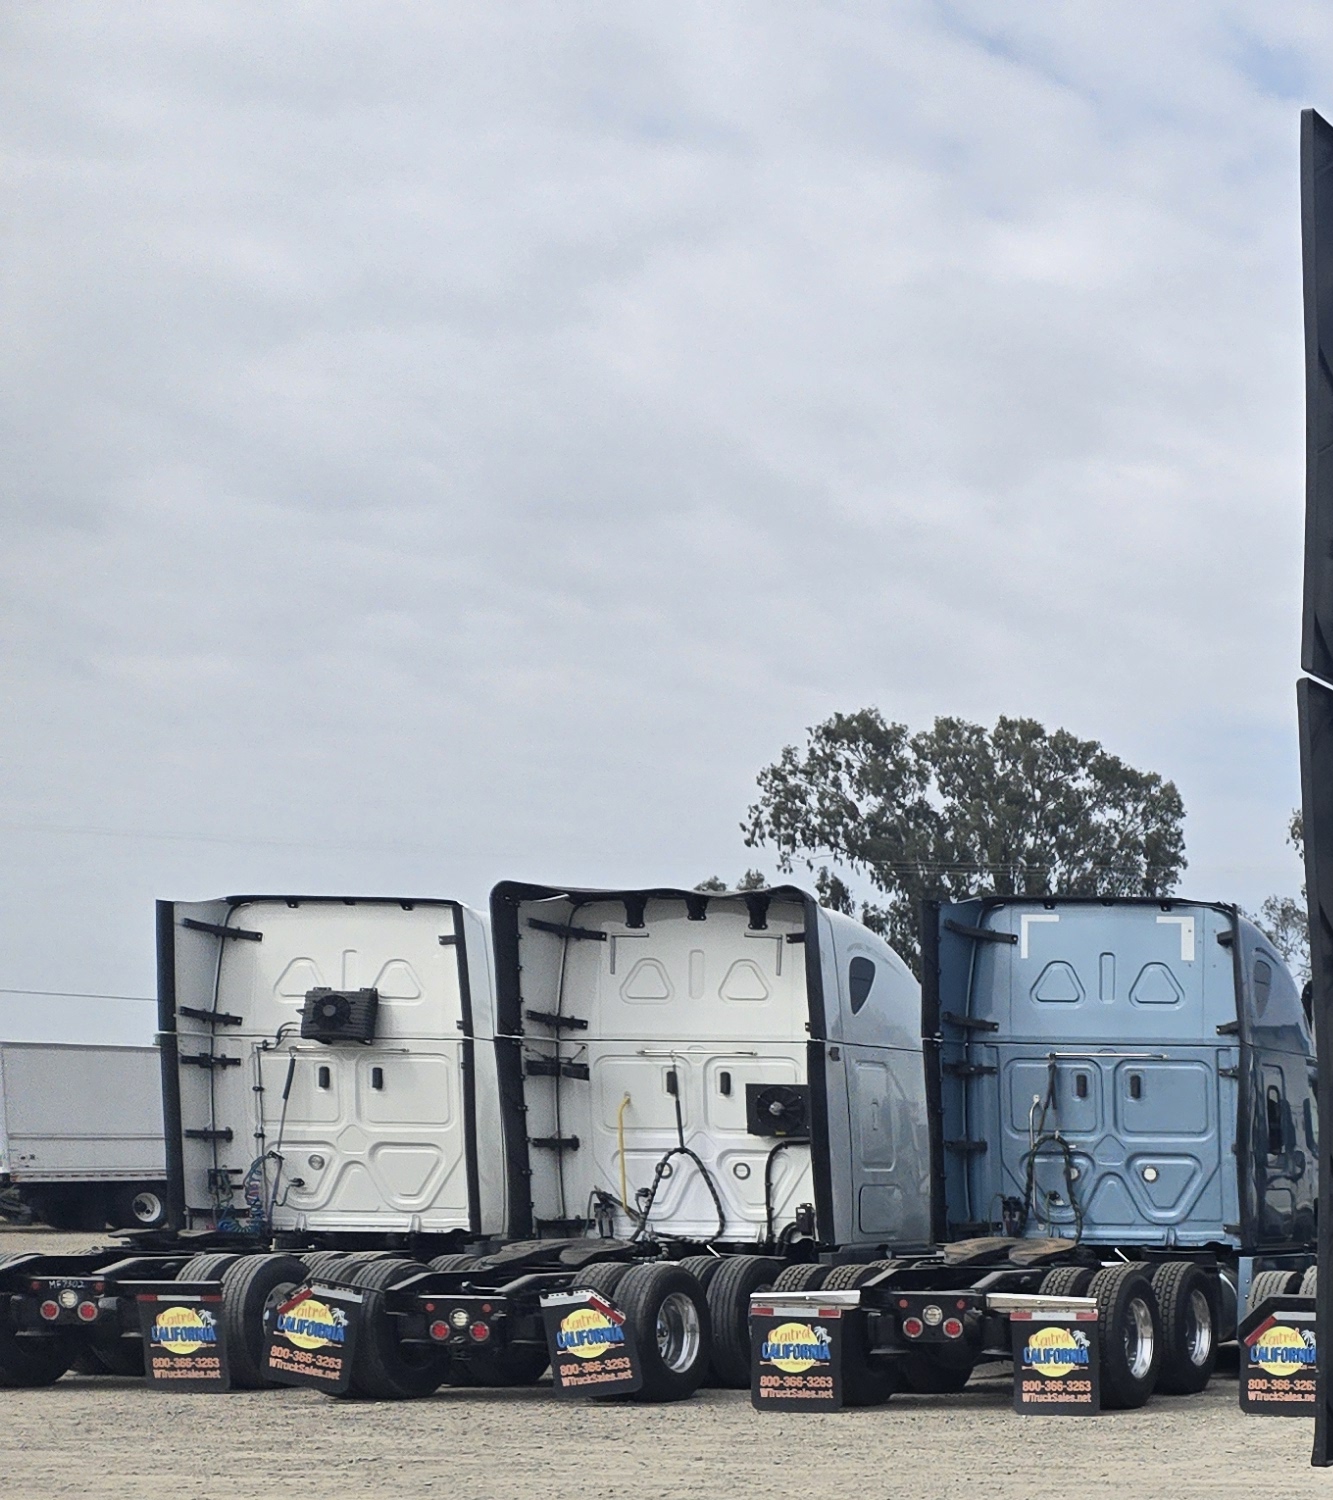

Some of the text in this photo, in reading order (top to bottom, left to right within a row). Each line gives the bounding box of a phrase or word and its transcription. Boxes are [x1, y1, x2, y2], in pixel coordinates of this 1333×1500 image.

[156, 1308, 196, 1326] Central
[151, 1326, 217, 1342] CALIFORNIA
[277, 1314, 345, 1342] CALIFORNIA
[557, 1325, 625, 1348] CALIFORNIA
[768, 1324, 811, 1343] Central
[1028, 1328, 1070, 1348] Central
[270, 1345, 342, 1369] 800-366-3263
[762, 1342, 831, 1360] CALIFORNIA
[1023, 1347, 1089, 1364] CALIFORNIA
[1250, 1345, 1316, 1363] CALIFORNIA
[153, 1358, 220, 1368] 800-366-3263
[269, 1357, 340, 1380] WTruckSales.net
[560, 1357, 631, 1376] 800-366-3263
[153, 1369, 221, 1379] WTruckSales.net
[561, 1369, 633, 1387] WTruckSales.net
[760, 1375, 833, 1387] 800-366-3263
[760, 1388, 834, 1398] WTruckSales.net
[1022, 1380, 1091, 1391] 800-366-3263
[1022, 1392, 1091, 1402] WTruckSales.net
[1248, 1391, 1316, 1402] WTruckSales.ne
